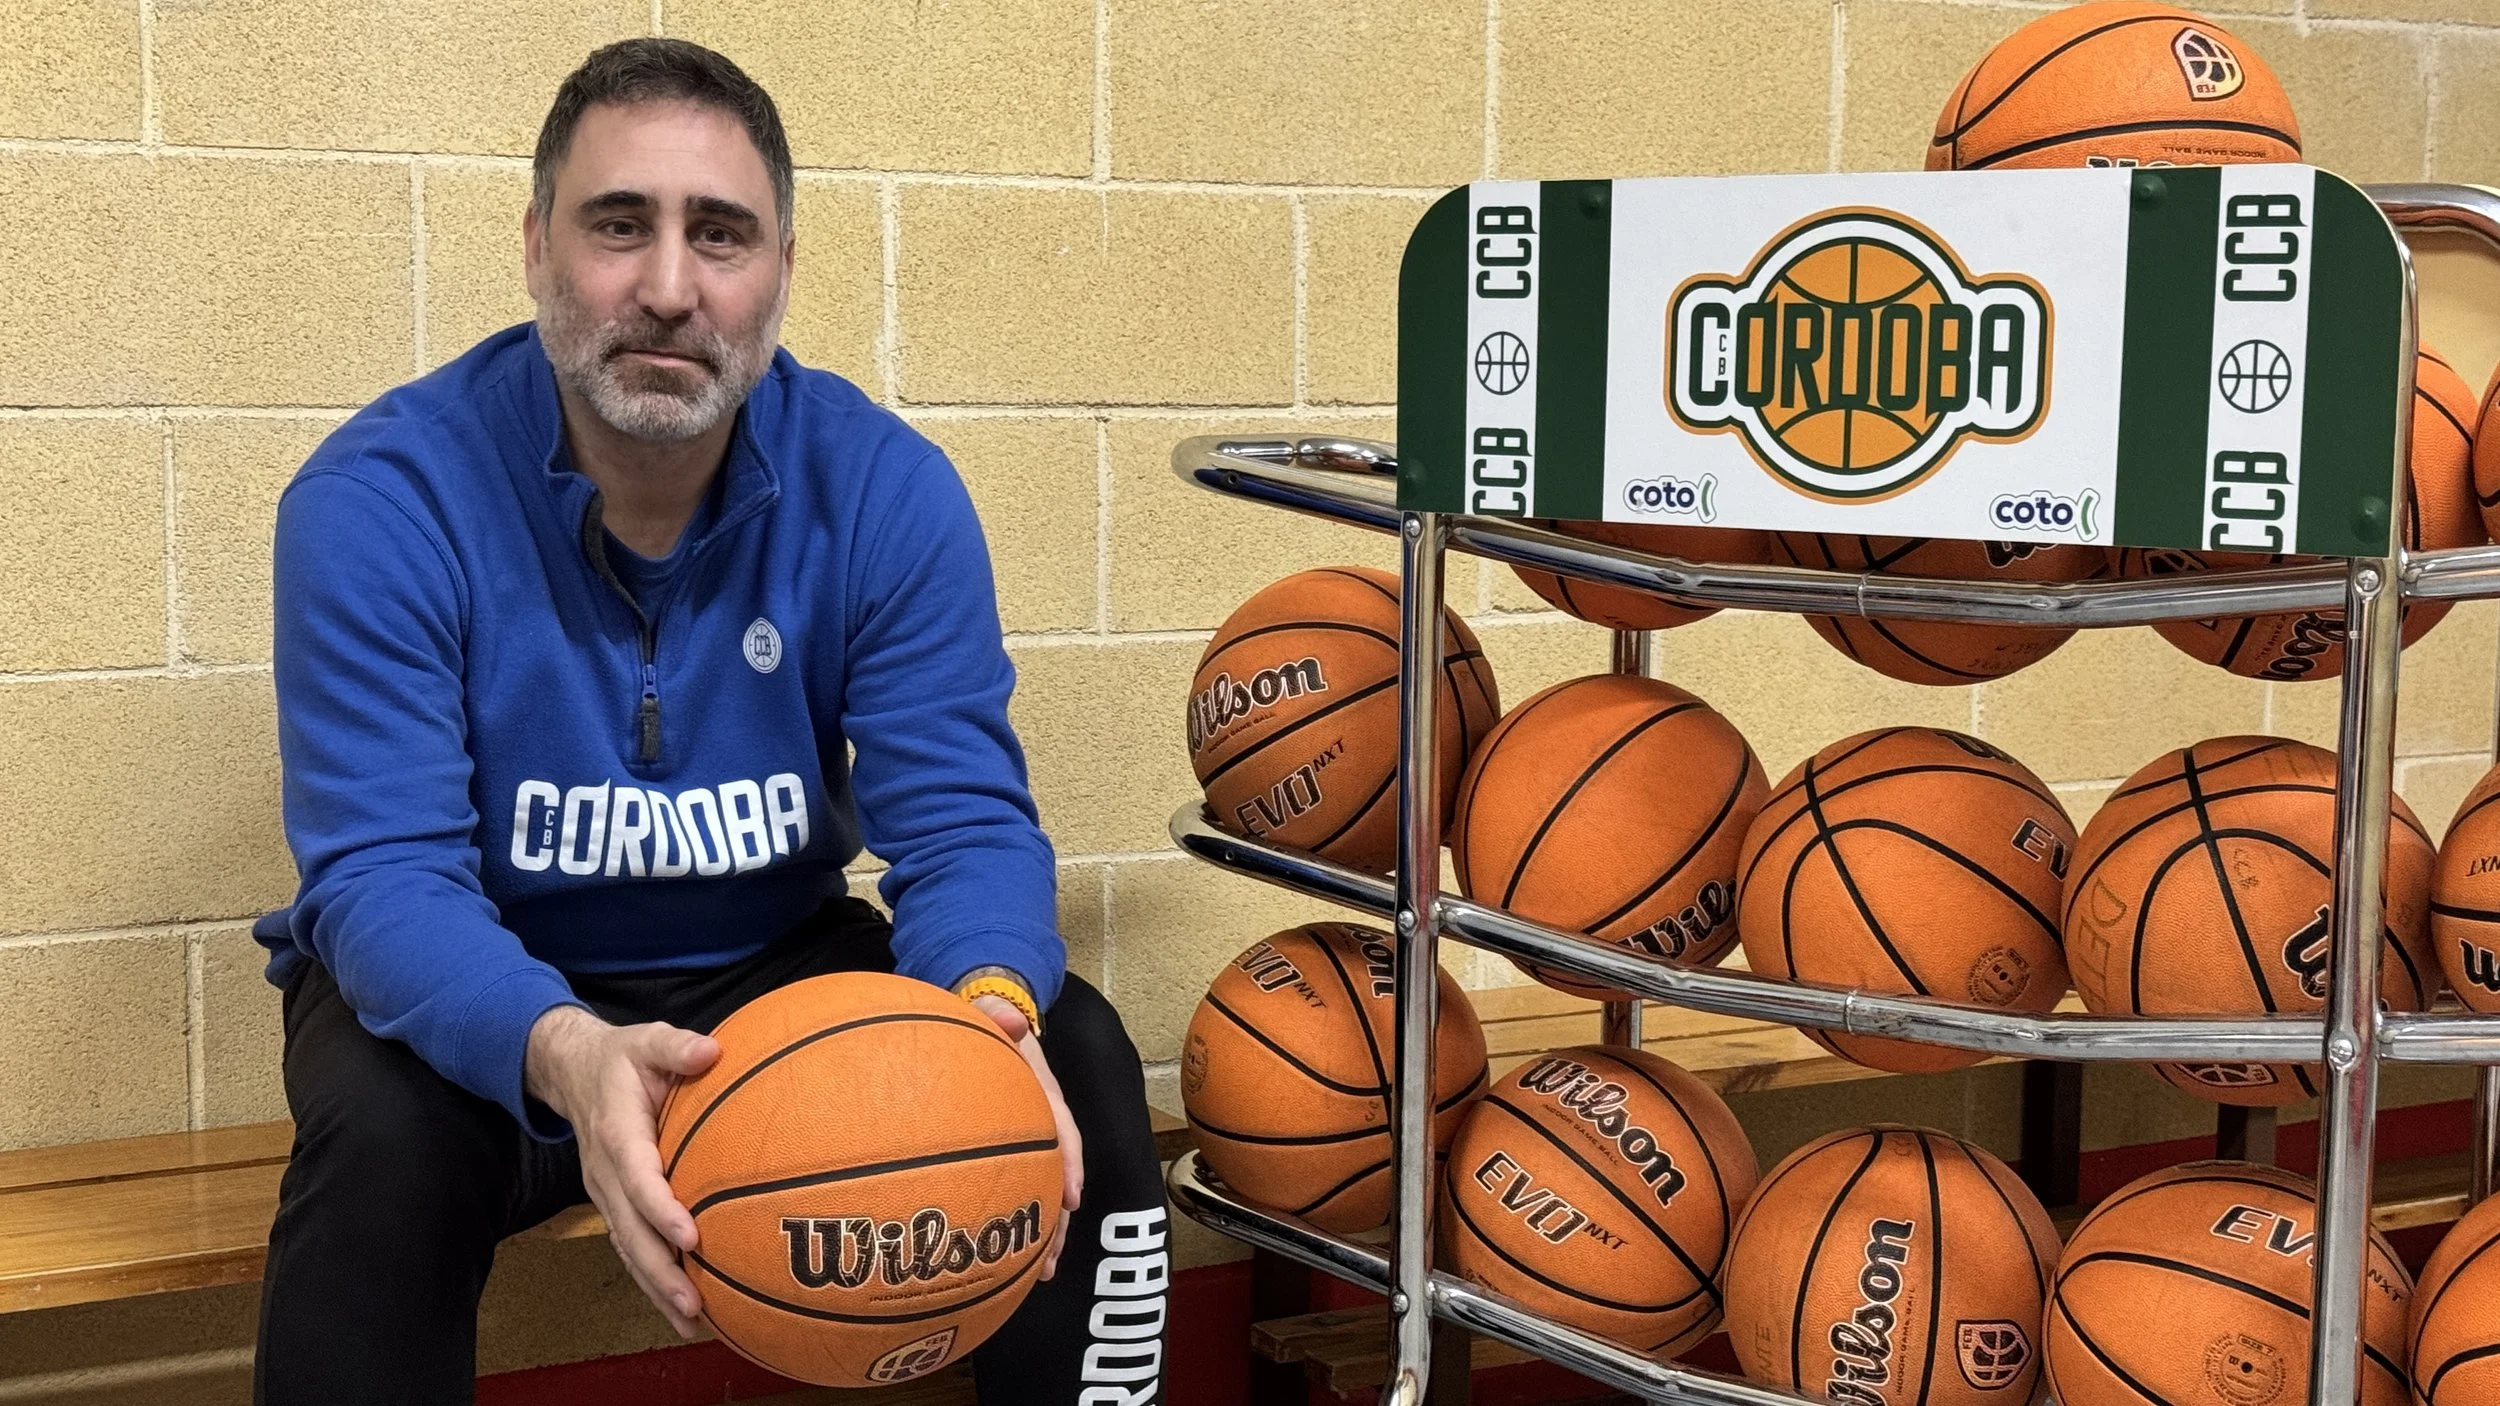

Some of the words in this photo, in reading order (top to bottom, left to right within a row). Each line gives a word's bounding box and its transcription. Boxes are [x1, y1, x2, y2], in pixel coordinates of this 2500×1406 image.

[1476, 206, 1538, 299] CCB
[2223, 193, 2308, 302] CCB
[1472, 427, 1533, 518] CCB
[1629, 481, 1695, 508] coto
[1996, 497, 2073, 525] coto
[2209, 450, 2295, 553] CCB
[1234, 764, 1323, 838] EVO
[1312, 738, 1345, 772] NXT
[1294, 982, 1327, 1009] NXT
[1517, 1058, 1687, 1209] Wilson
[780, 1200, 1042, 1291] Wilson
[1473, 1151, 1588, 1244] EVO
[1583, 1221, 1629, 1251] NXT
[2210, 1203, 2315, 1268] EV
[2367, 1268, 2401, 1302] NXT
